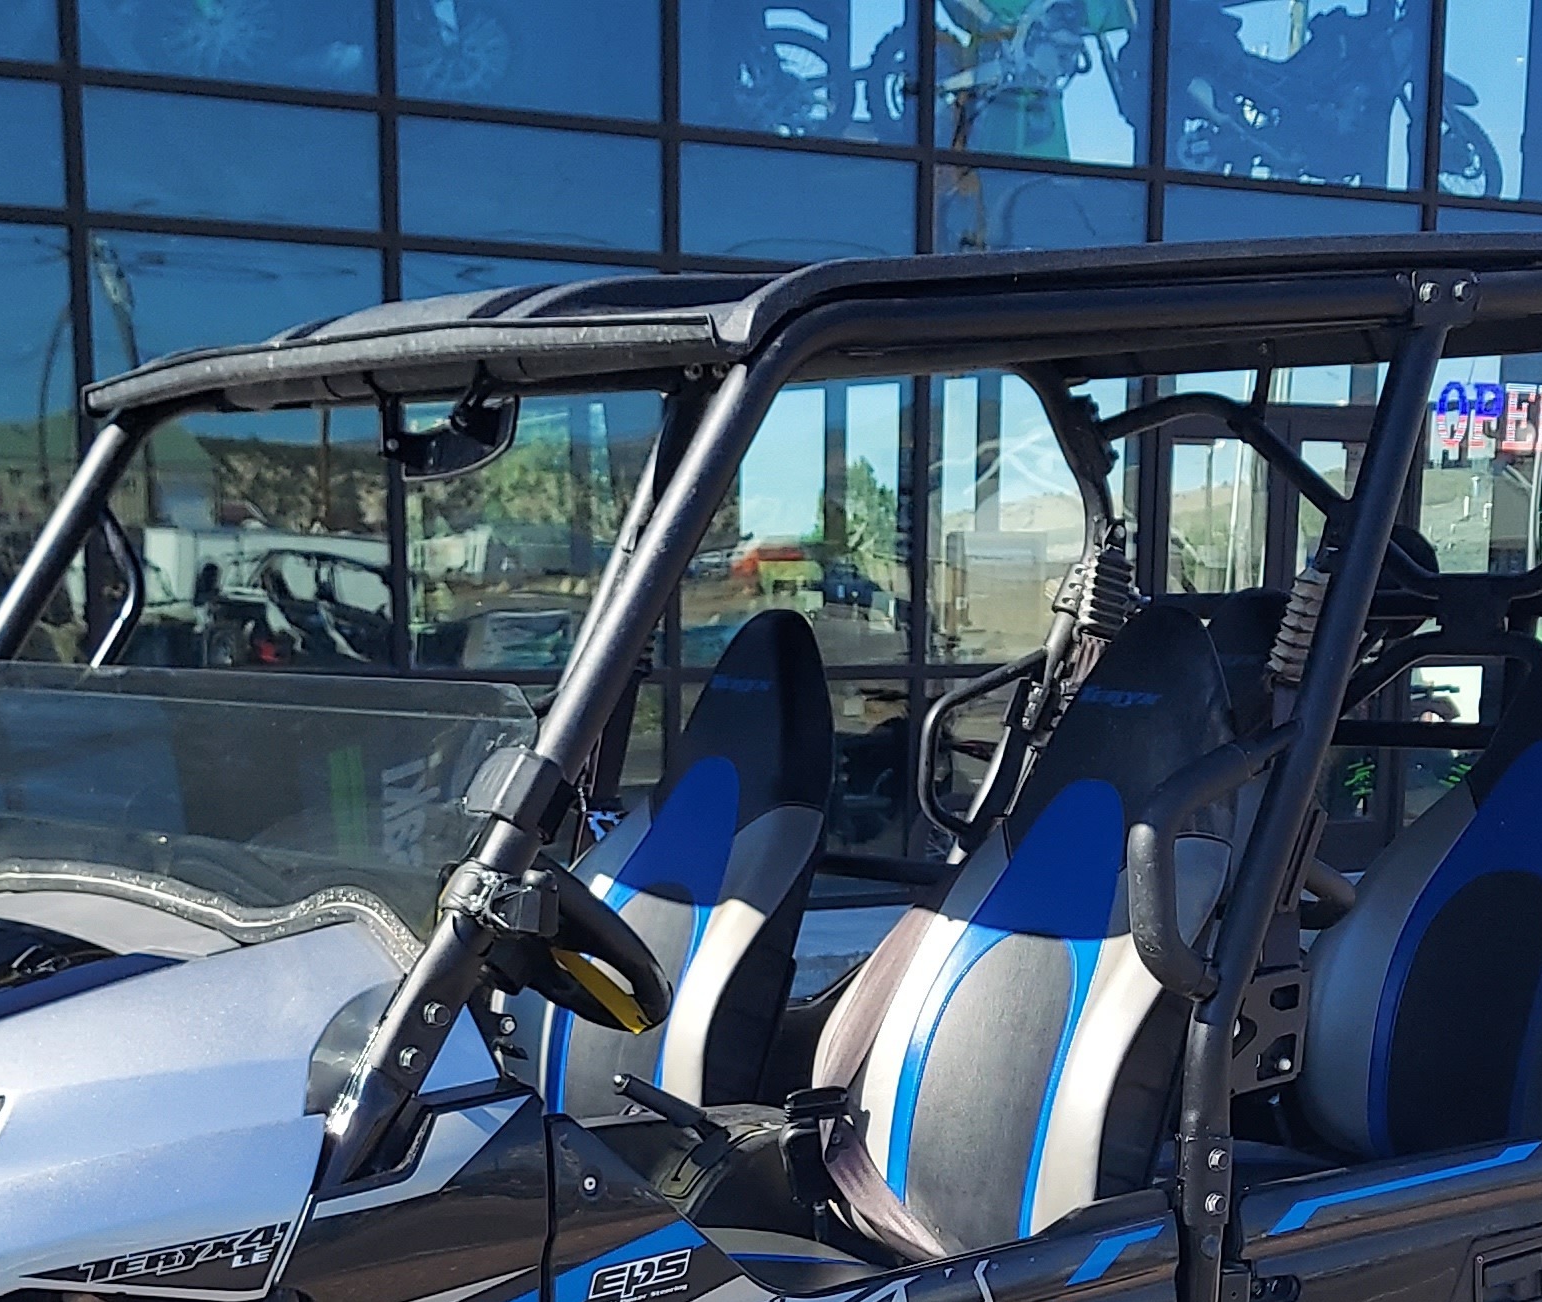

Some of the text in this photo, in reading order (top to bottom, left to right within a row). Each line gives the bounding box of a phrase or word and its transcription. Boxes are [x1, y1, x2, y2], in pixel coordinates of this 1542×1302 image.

[231, 1249, 273, 1269] LE
[588, 1248, 692, 1300] EPS
[650, 1284, 689, 1297] Steering
